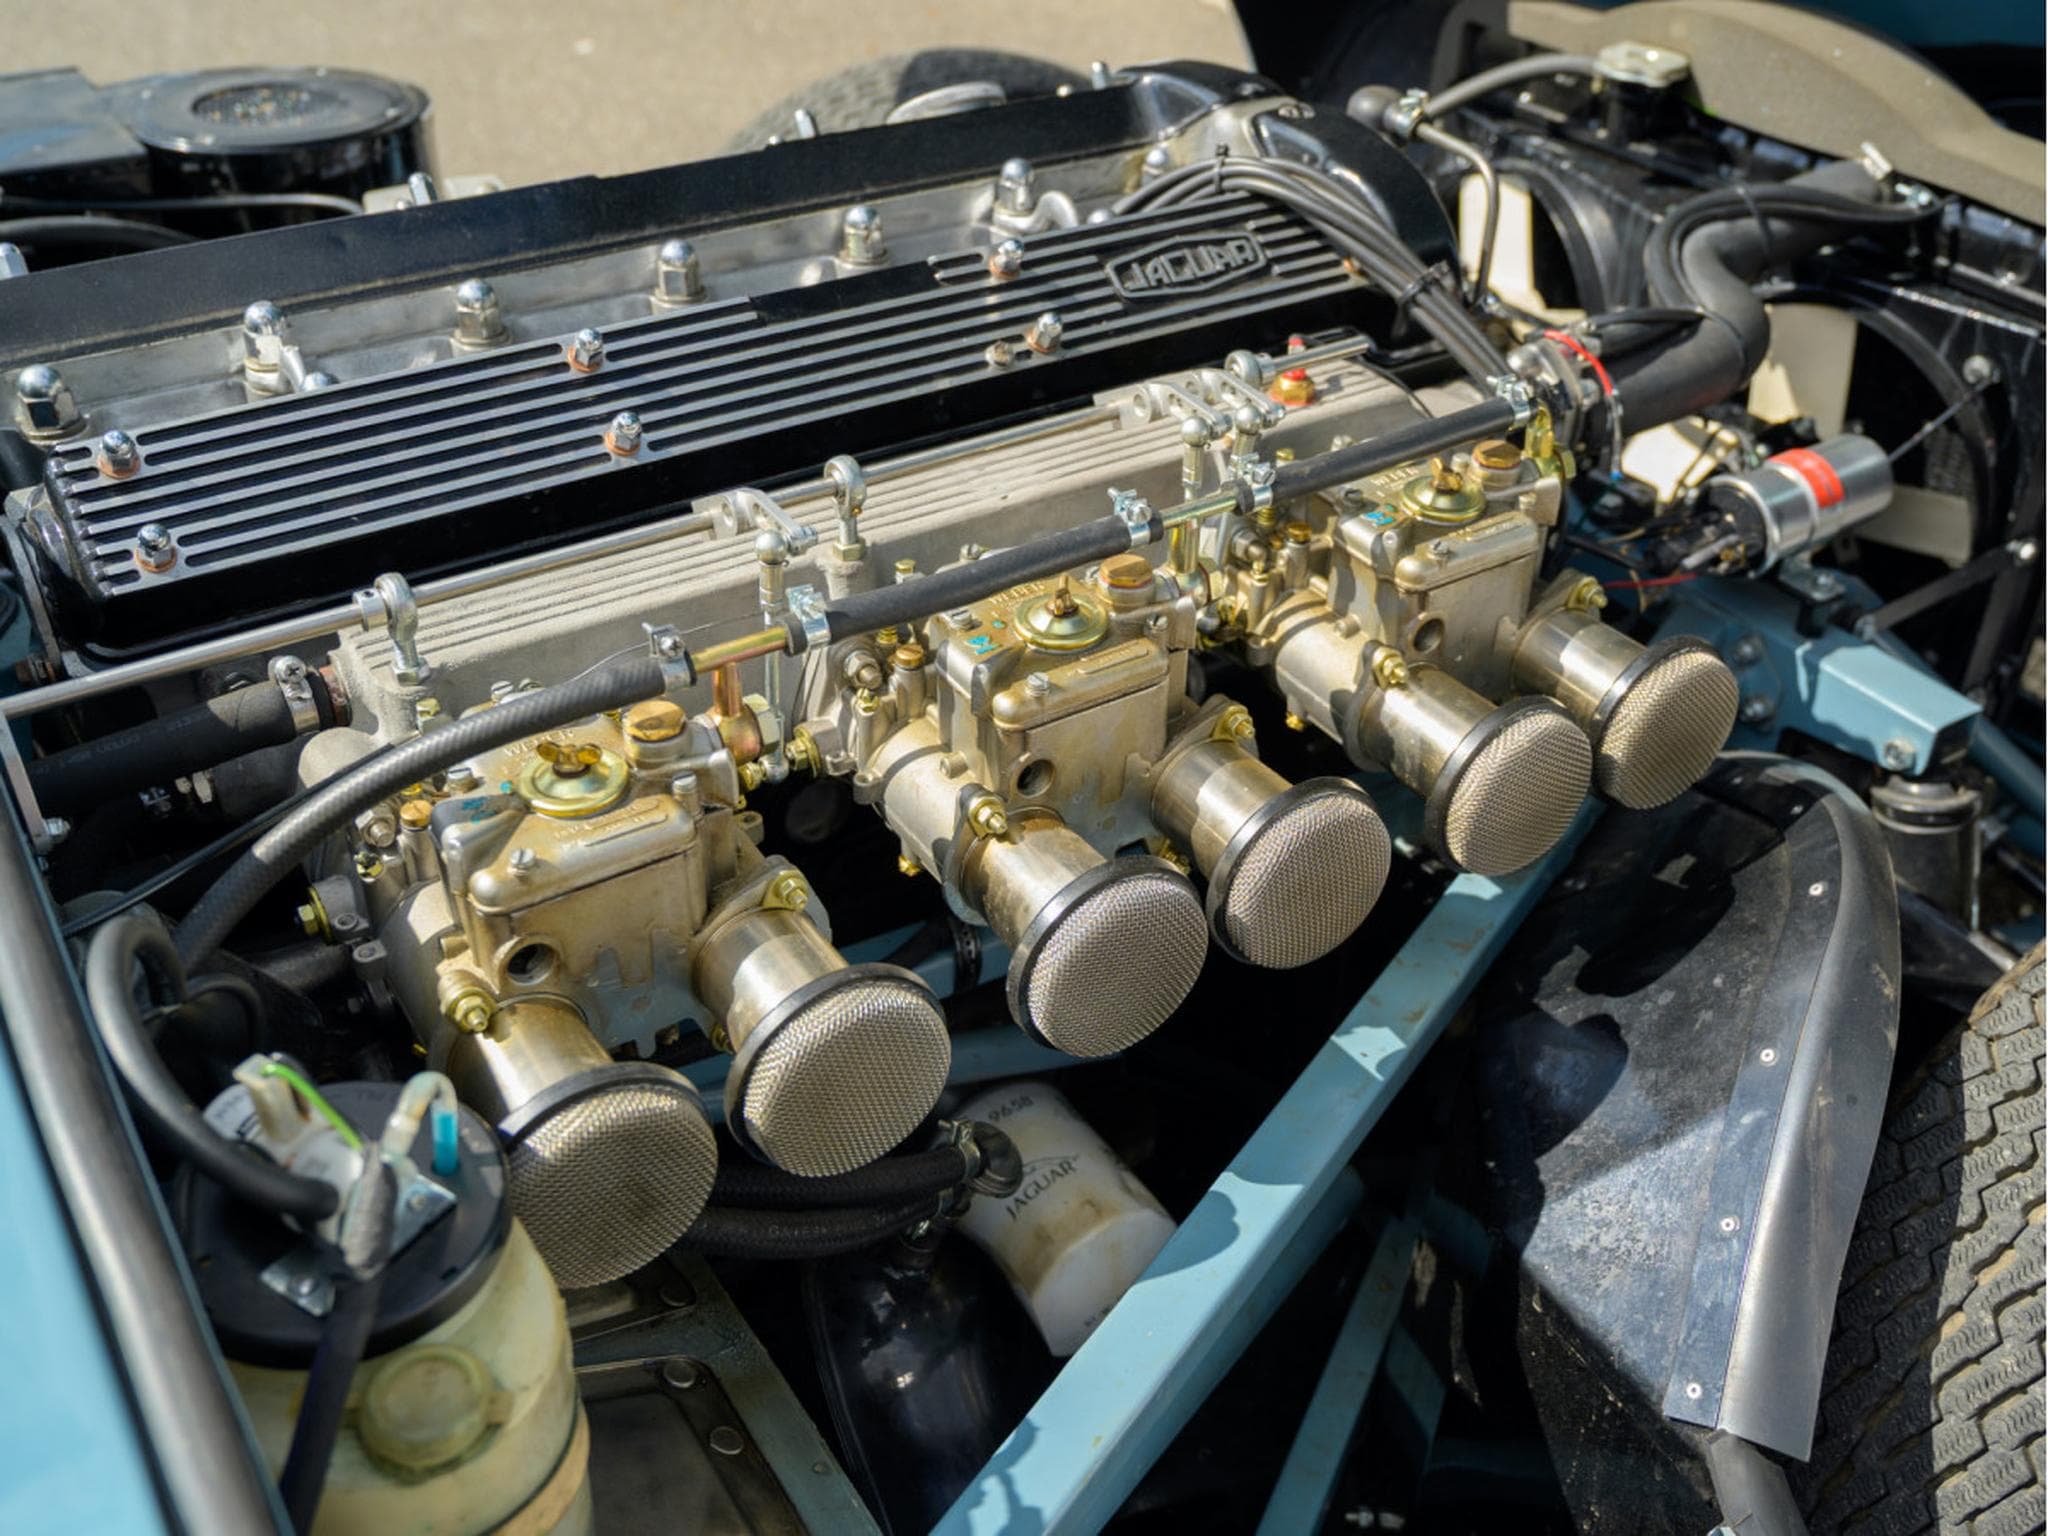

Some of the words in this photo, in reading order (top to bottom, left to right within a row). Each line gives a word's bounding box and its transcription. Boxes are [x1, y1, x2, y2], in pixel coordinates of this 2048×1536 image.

[1124, 238, 1255, 291] JAGUAR
[988, 1095, 1035, 1121] 9658
[1005, 1159, 1078, 1221] JAGUAR
